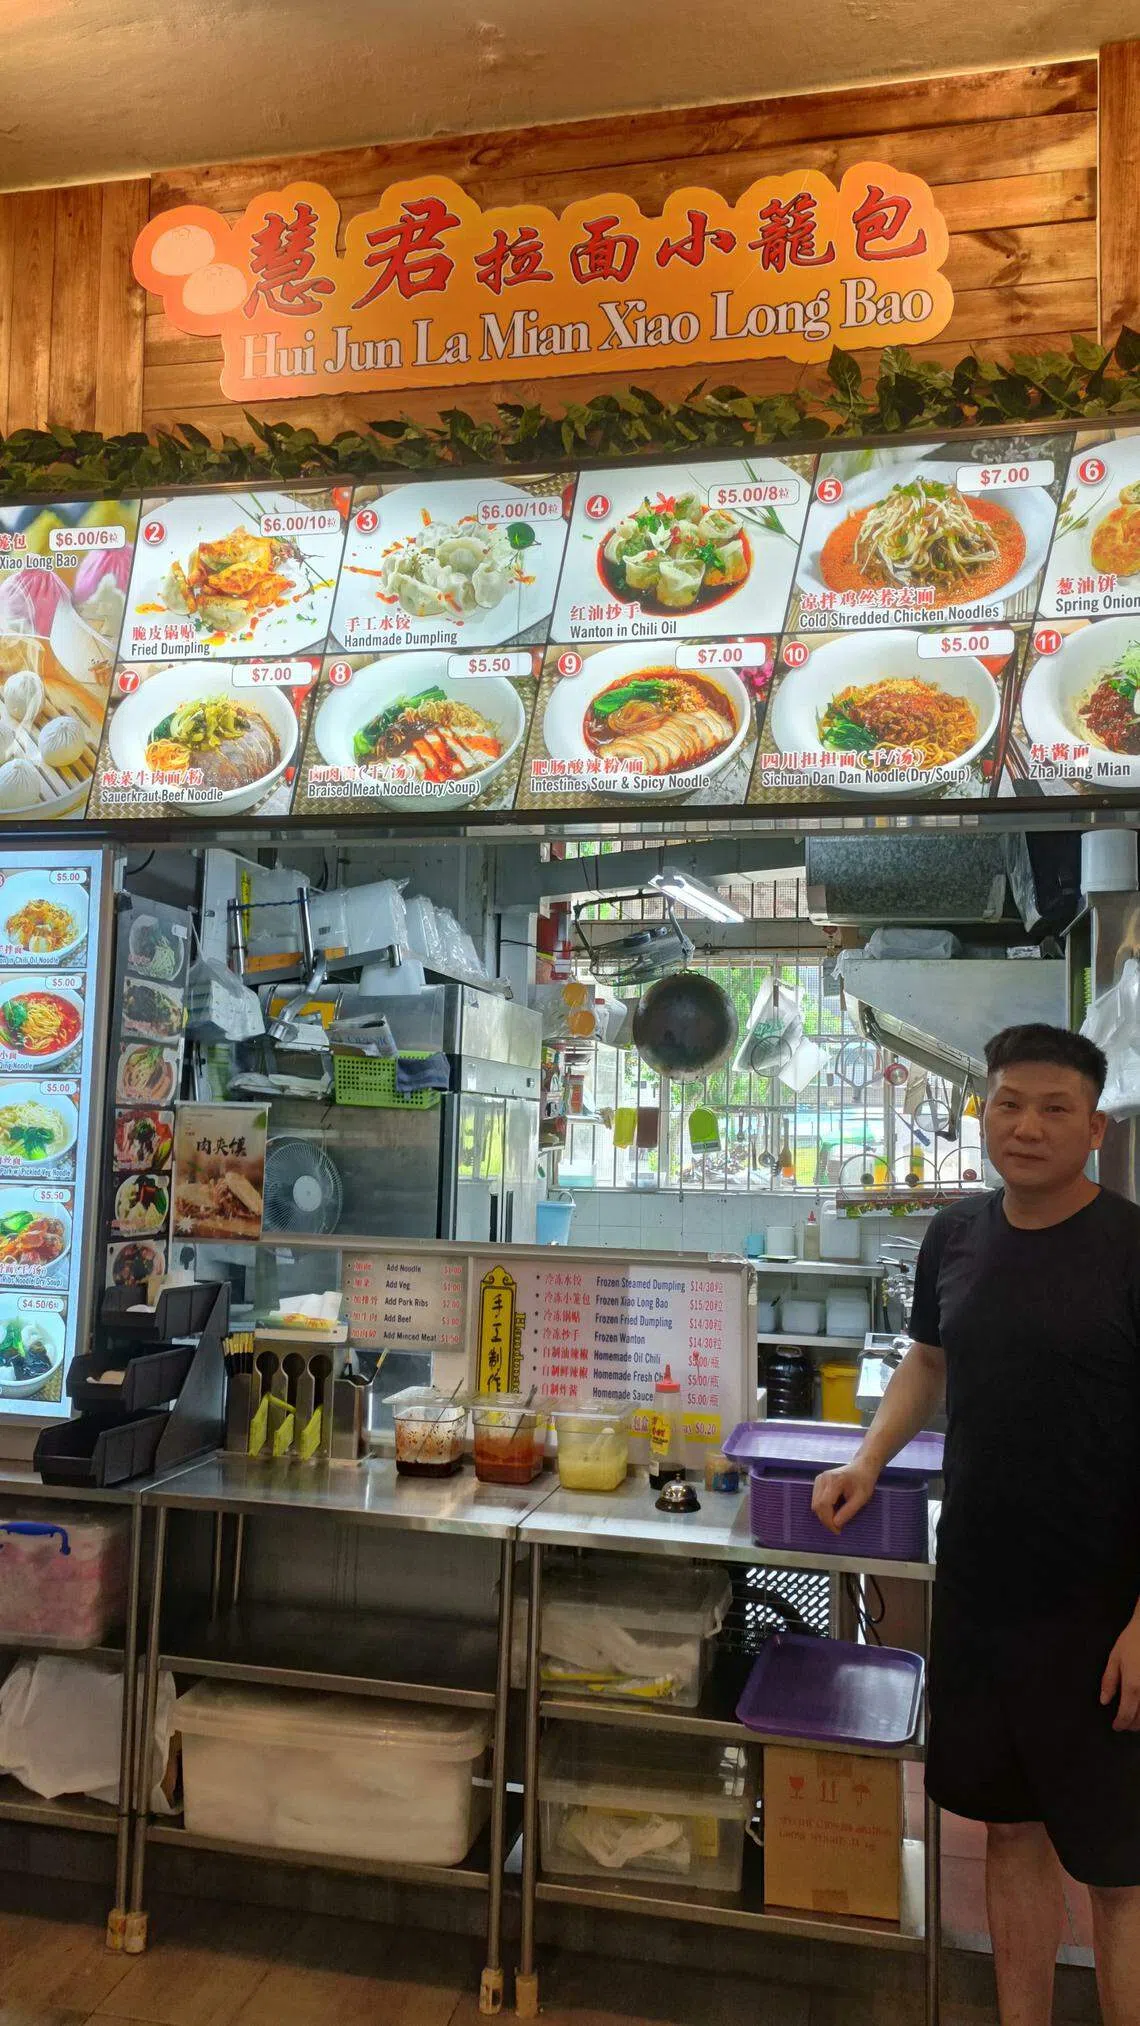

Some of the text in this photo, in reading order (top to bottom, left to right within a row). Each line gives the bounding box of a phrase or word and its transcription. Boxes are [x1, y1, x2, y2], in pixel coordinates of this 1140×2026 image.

[244, 184, 929, 319] 慧君拉面小籠包
[242, 278, 933, 381] Hui Jun La Mian Xiao Long Bao
[980, 467, 1029, 486] $7.00
[1086, 463, 1098, 479] 6
[824, 482, 836, 498] 5
[592, 499, 603, 515] 4
[362, 513, 373, 529] 3
[149, 524, 160, 541] 2
[0, 553, 77, 570] Xiao Long Bao
[1056, 575, 1117, 595] 葱油饼
[801, 587, 936, 611] 凉拌鸡丝荞麦面
[1056, 595, 1140, 614] Spring Onion
[570, 602, 640, 621] 红油抄手
[801, 606, 999, 627] Cold Shredded Chicken Noodles
[346, 614, 411, 633] 手工水饺
[570, 621, 677, 638] Wanton in Chili Oil
[132, 624, 196, 640] 脆皮锅贴
[345, 631, 457, 647] Handmade Dumpling
[131, 641, 210, 656] Fried Dumpling
[941, 636, 990, 653] $5.00
[1039, 635, 1058, 650] 11
[698, 647, 742, 666] $7.00
[786, 646, 804, 661] 10
[468, 657, 511, 674] $5.50
[564, 656, 576, 673] 9
[123, 674, 135, 690] 7
[252, 667, 292, 683] $7.00
[335, 667, 346, 682] 8
[1031, 743, 1091, 761] 炸酱面
[532, 758, 644, 776] 肥肠酸辣粉/面
[1030, 762, 1130, 779] Zha Jiang Mian
[102, 768, 204, 786] 酸菜牛肉面/粉
[531, 774, 710, 792] Intestines Sour & Spicy Noodle
[763, 767, 972, 786] Sichuan Dan Dan Noodle(Dry/Soup)
[102, 788, 223, 803] Sauerkraut Beef Noodle
[309, 781, 481, 797] Braised Meat Noodle(Dry/Soup)
[57, 873, 80, 882] $5.00
[40, 957, 59, 965] Noodle
[52, 978, 76, 987] $5.00
[13, 1061, 33, 1070] Noodle
[47, 1083, 70, 1093] $5.00
[40, 1191, 64, 1200] $5.50
[386, 1264, 462, 1275] Add Noodle $1.00
[386, 1280, 462, 1292] Add Veg $1.00
[596, 1276, 619, 1288] Frozen
[621, 1277, 650, 1290] Steamed
[653, 1279, 686, 1293] Dumpling
[385, 1297, 396, 1306] Add
[398, 1298, 413, 1307] Pork
[414, 1299, 428, 1308] Ribs
[596, 1294, 619, 1307] Frozen
[620, 1296, 635, 1307] Xiao
[637, 1297, 653, 1310] Long
[655, 1298, 669, 1309] Bao
[384, 1314, 396, 1323] Add
[397, 1315, 412, 1324] Beef
[595, 1313, 619, 1325] Frozen
[620, 1314, 638, 1326] Fried
[639, 1315, 673, 1330] Dumpling
[384, 1331, 395, 1340] Add
[397, 1332, 420, 1341] Minced
[421, 1333, 437, 1343] Meat
[594, 1331, 618, 1343] Frozen
[619, 1332, 646, 1345] Wanton
[593, 1350, 632, 1363] Homemade
[633, 1351, 644, 1363] Oil
[645, 1352, 661, 1365] Chili
[593, 1368, 631, 1381] Homemade
[633, 1370, 653, 1383] Fresh
[592, 1387, 631, 1399] Homemade
[632, 1389, 654, 1402] Sauce
[695, 1421, 717, 1435] $0.20
